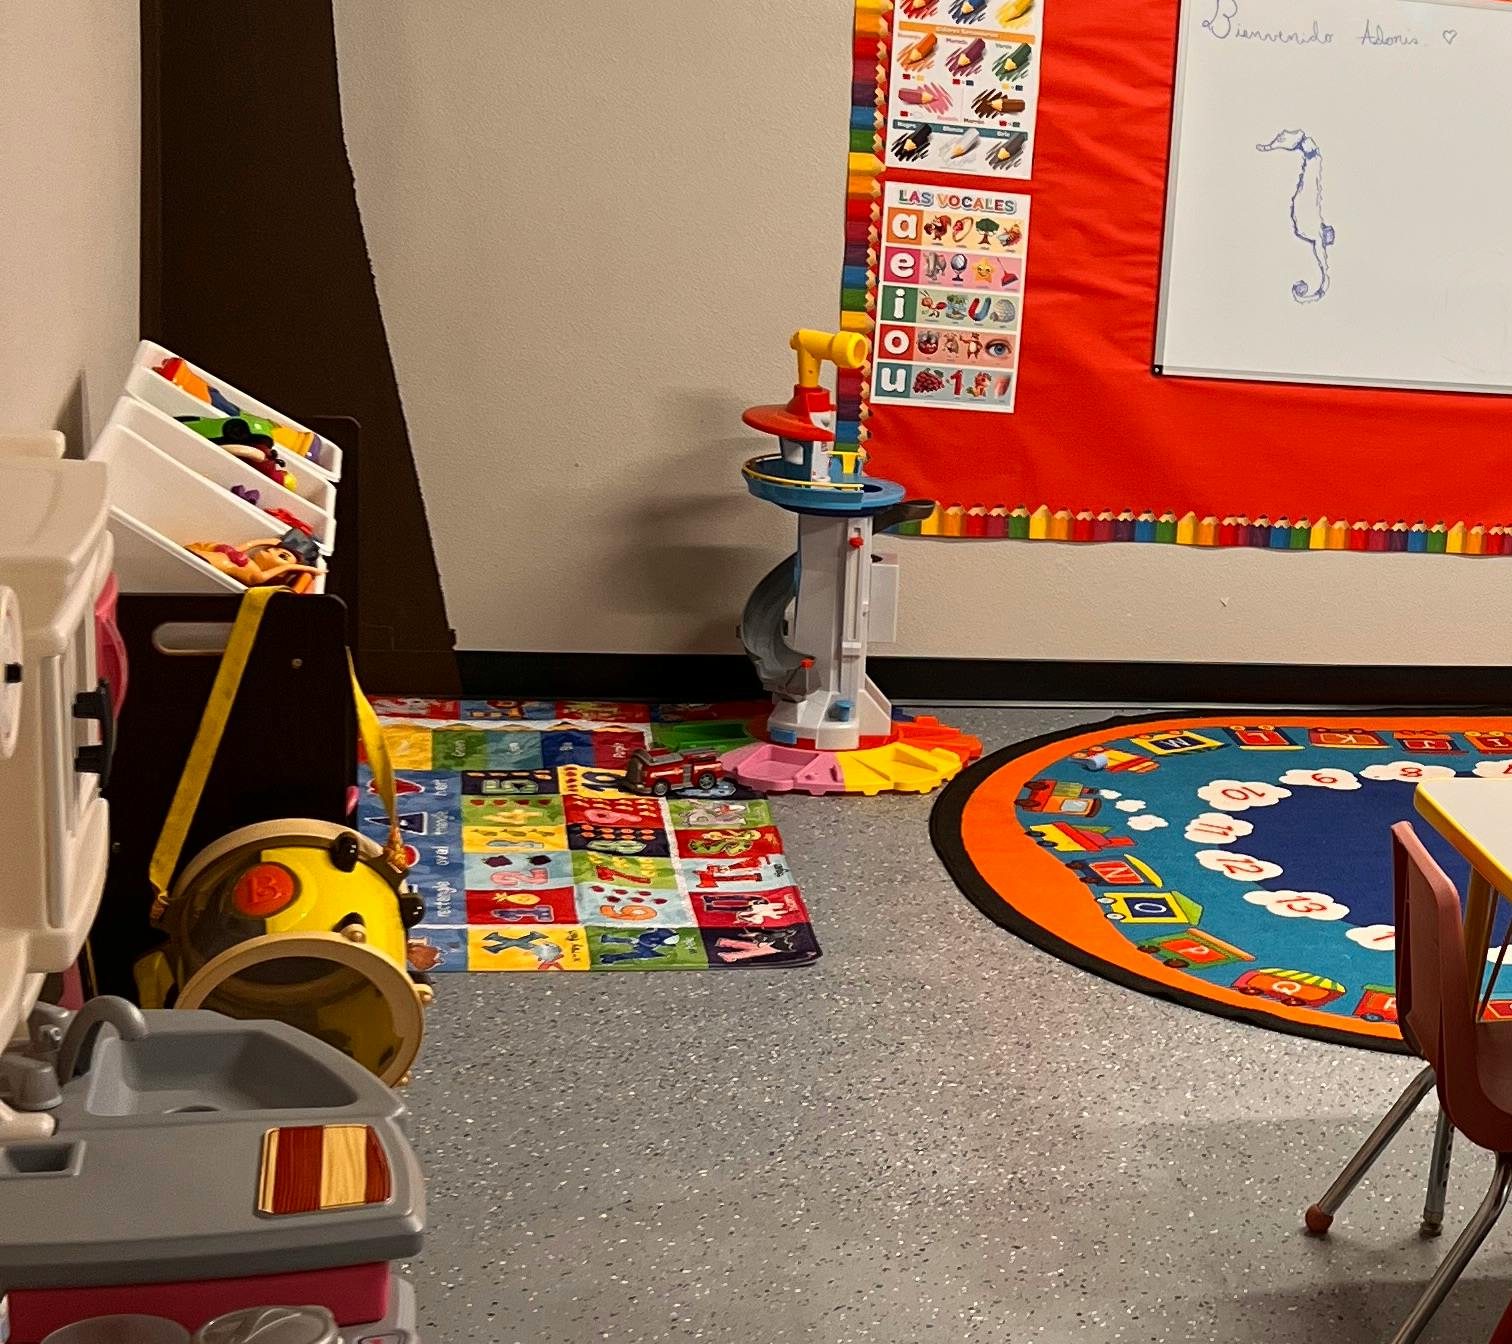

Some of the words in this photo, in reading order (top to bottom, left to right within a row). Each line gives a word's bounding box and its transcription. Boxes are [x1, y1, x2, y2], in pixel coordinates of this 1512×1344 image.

[899, 189, 933, 206] LAS
[937, 192, 1017, 214] VOCALES
[892, 213, 917, 239] a
[890, 252, 914, 277] e
[894, 289, 905, 319] i
[883, 329, 909, 354] o
[881, 367, 906, 393] u
[1341, 735, 1359, 744] K
[1400, 766, 1422, 778] 8
[481, 778, 538, 794] 5
[1221, 786, 1266, 801] 10
[1198, 822, 1233, 837] 11
[436, 846, 449, 866] oval
[595, 865, 651, 884] 7
[1102, 866, 1133, 879] N
[1216, 858, 1263, 875] 12
[490, 867, 549, 886] 2
[600, 905, 657, 921] 6
[1277, 896, 1328, 913] 13
[490, 905, 555, 923] 1
[481, 931, 549, 954] X
[1180, 945, 1209, 955] P
[1272, 981, 1301, 995] Q
